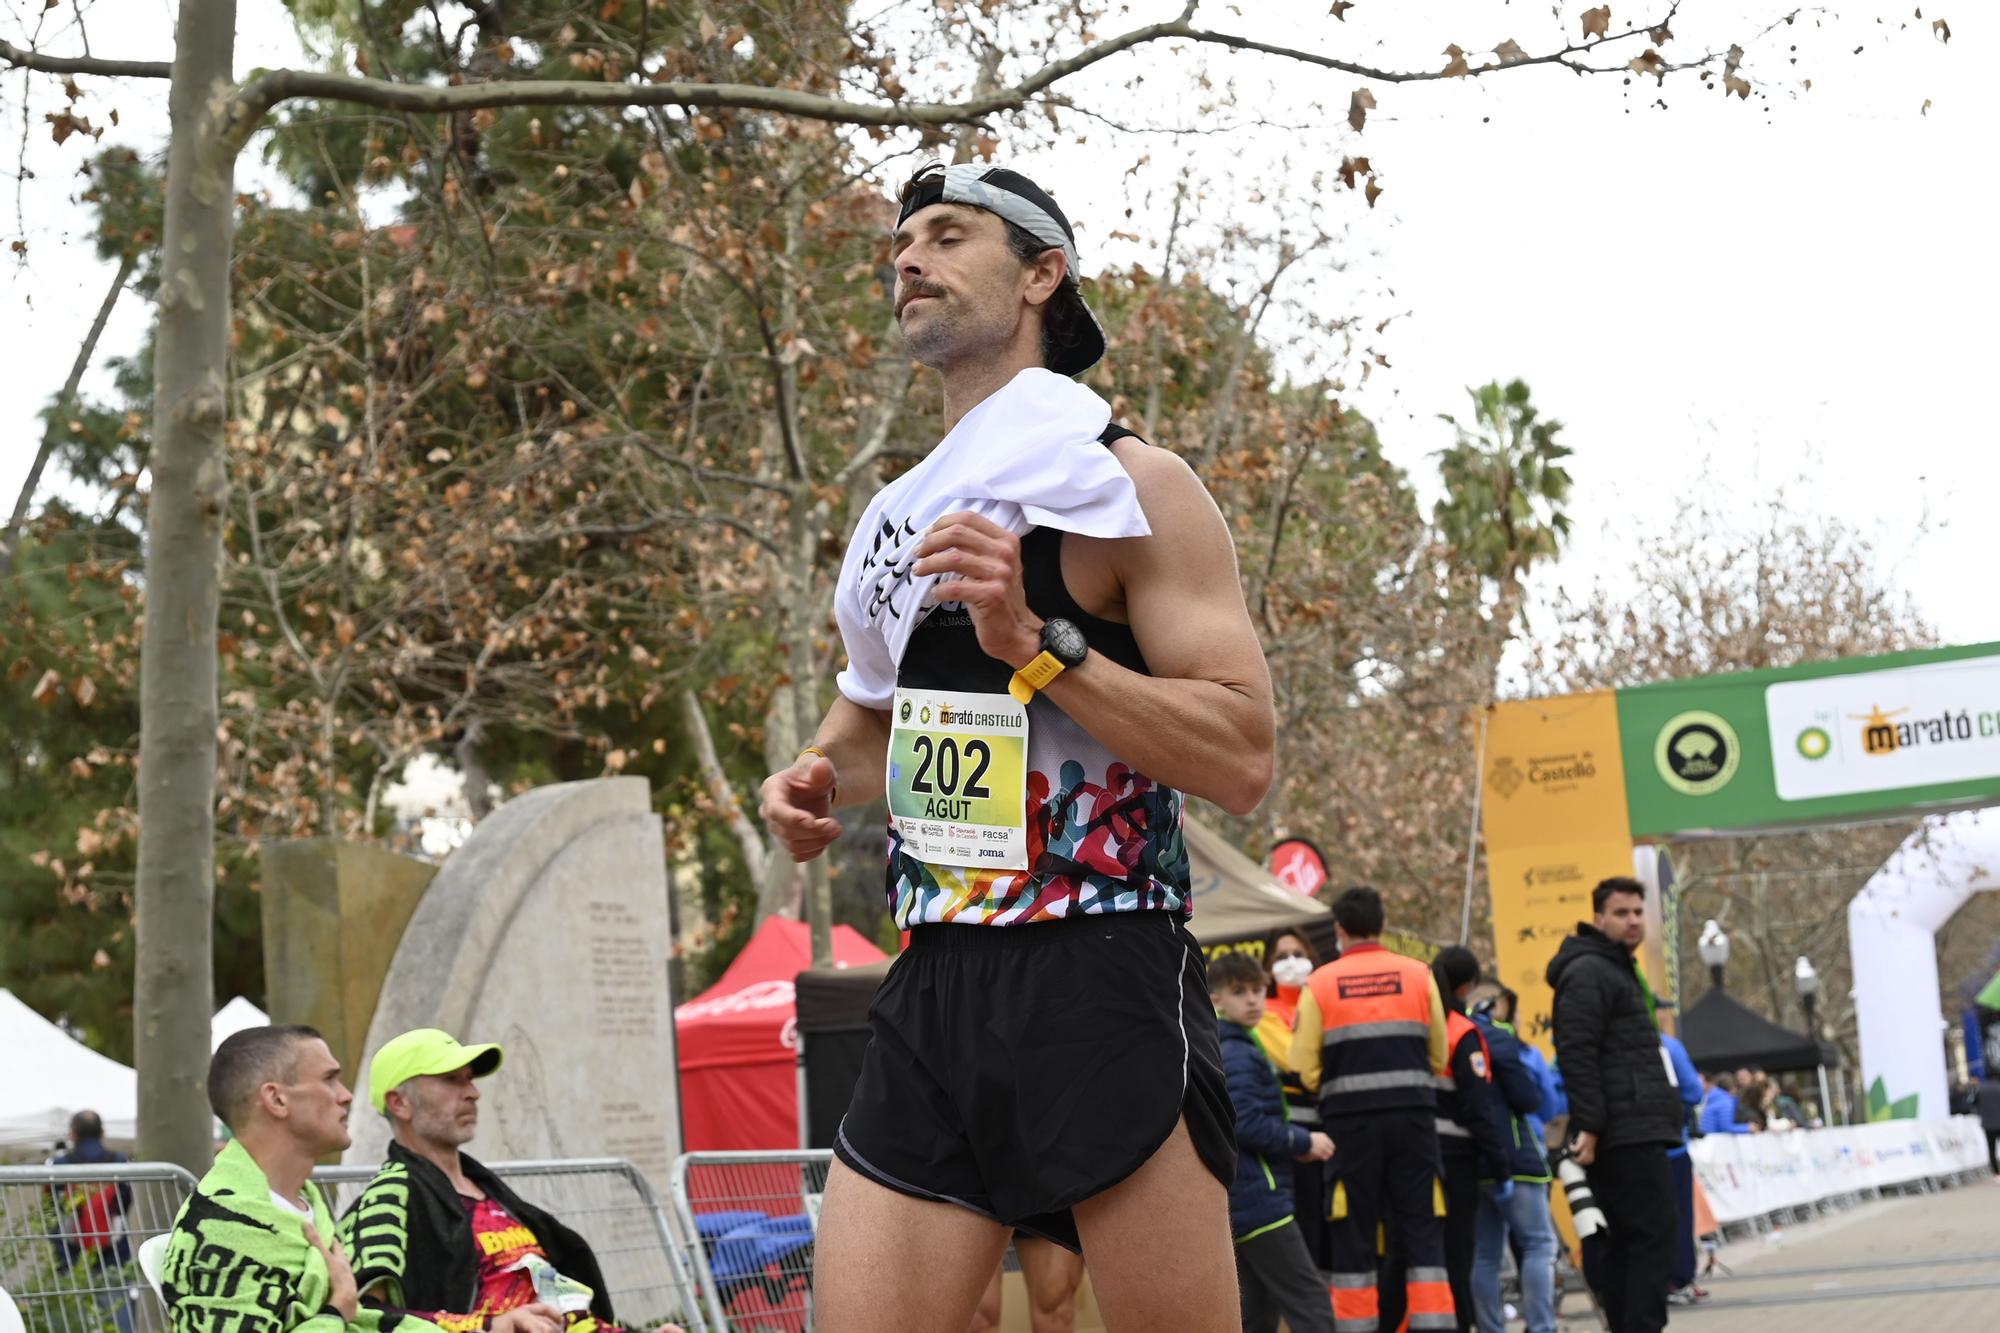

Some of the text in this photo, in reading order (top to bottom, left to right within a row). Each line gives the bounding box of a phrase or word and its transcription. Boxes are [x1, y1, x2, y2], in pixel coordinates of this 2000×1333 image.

[939, 615, 972, 628] ALMASS
[940, 709, 1022, 728] marató CASTELLÓ
[1867, 707, 1972, 753] marató
[911, 735, 990, 799] 202
[1528, 762, 1596, 784] Castelló
[925, 797, 971, 821] AGUT
